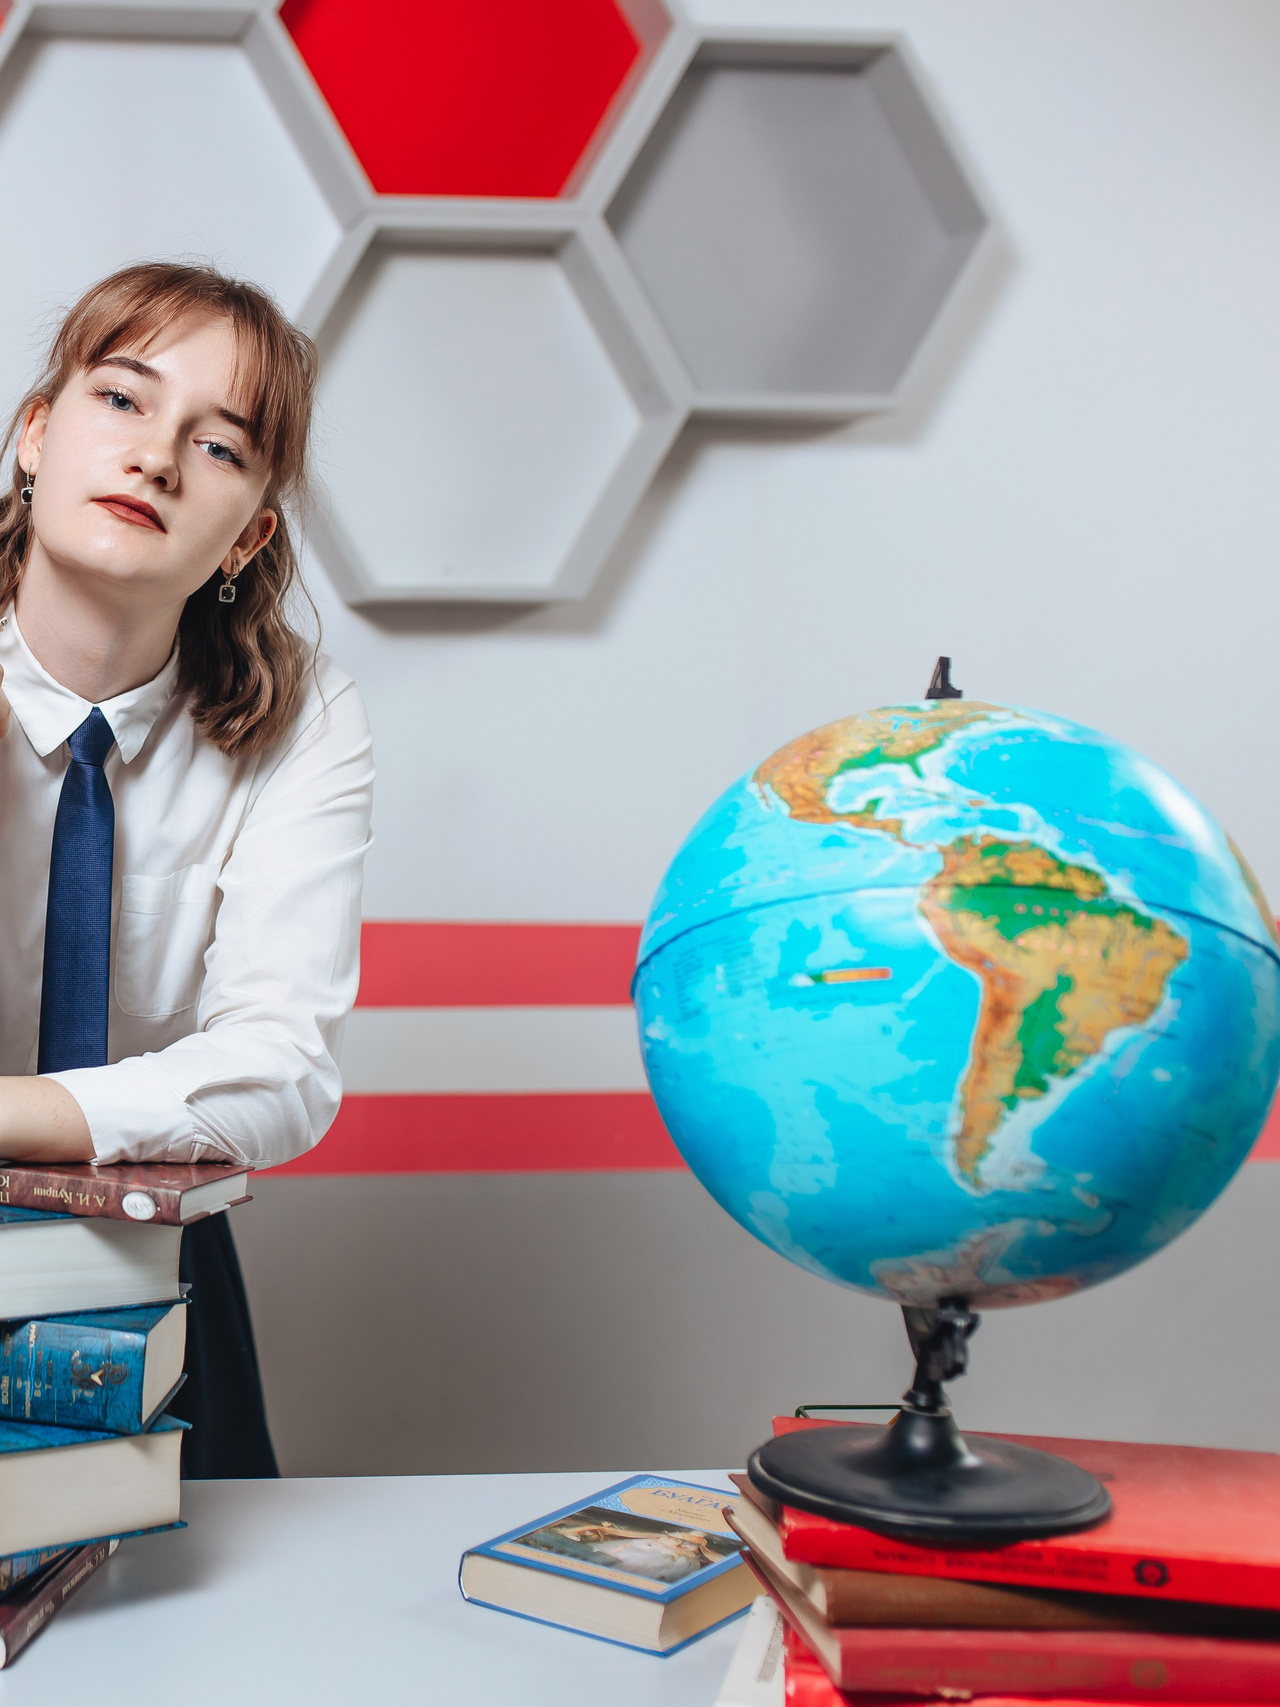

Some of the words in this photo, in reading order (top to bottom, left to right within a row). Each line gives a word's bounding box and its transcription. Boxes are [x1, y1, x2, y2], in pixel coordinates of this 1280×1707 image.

[33, 1187, 73, 1204] Куприн
[76, 1192, 90, 1206] И.
[93, 1194, 106, 1208] А.
